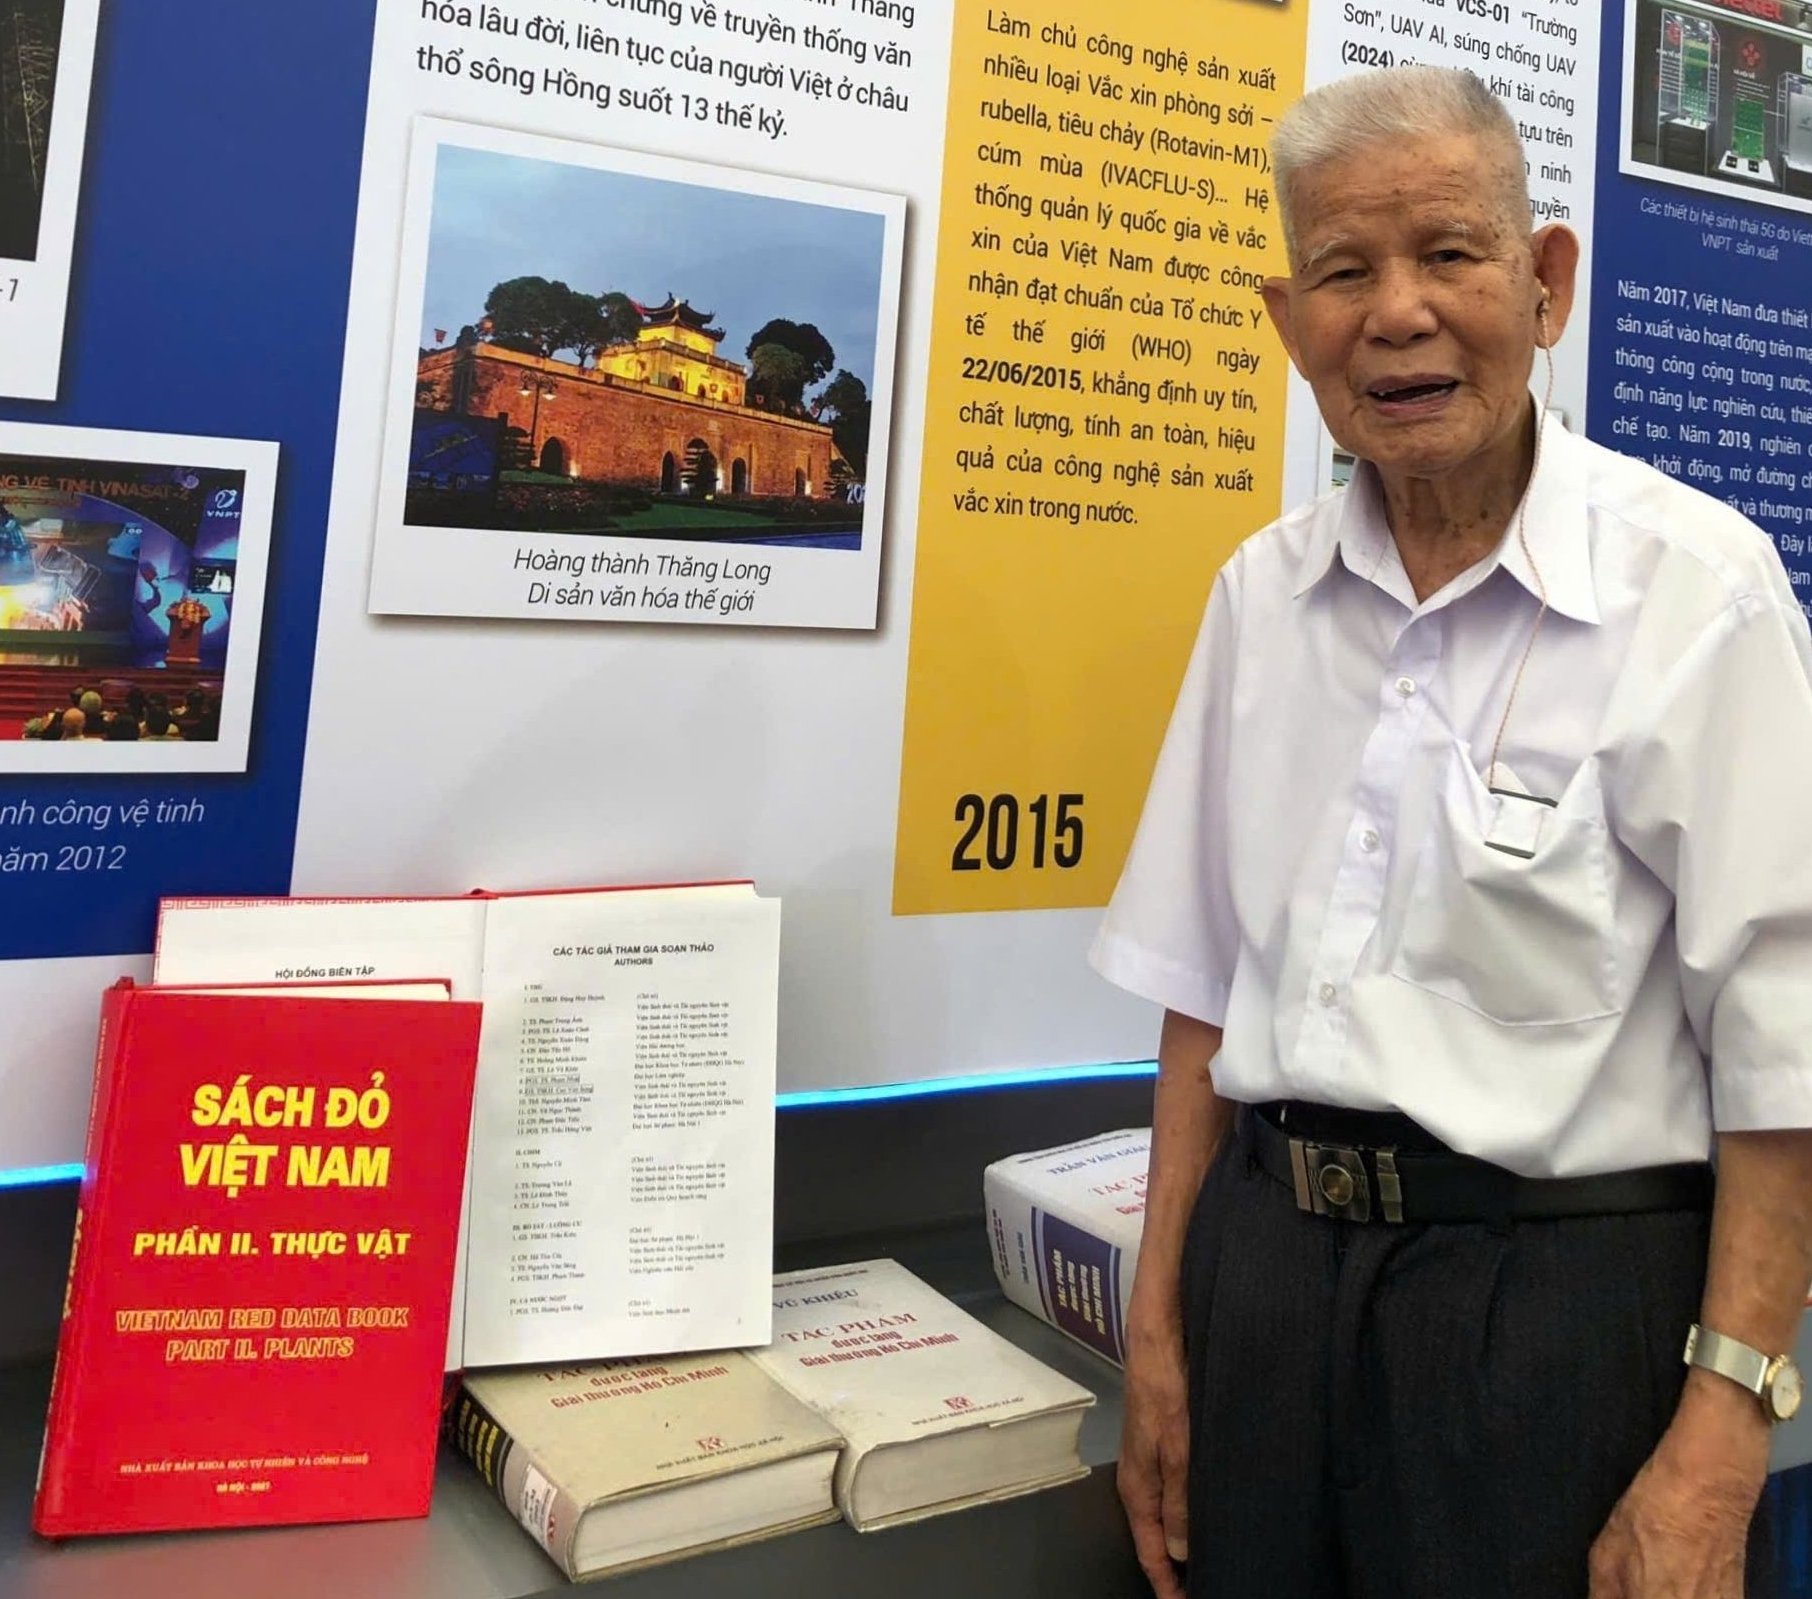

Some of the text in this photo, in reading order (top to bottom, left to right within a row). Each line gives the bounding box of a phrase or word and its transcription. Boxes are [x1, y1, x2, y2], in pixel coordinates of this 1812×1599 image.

[691, 5, 912, 67] về truyền thống văn
[1457, 0, 1510, 24] VCS-01
[420, 0, 909, 113] hóa lâu đời, liên tục của người Việt ở châu
[986, 9, 1277, 91] Làm chủ công nghệ sản xuất
[1391, 13, 1424, 38] UAV
[1453, 32, 1491, 60] súng
[1495, 42, 1541, 73] chống
[1546, 53, 1576, 76] UAV
[417, 45, 788, 140] thổ sông Hồng suốt 13 thế kỷ.
[983, 54, 1254, 127] nhiều loại Vắc xin phòng sởi
[1341, 40, 1575, 116] (2024) khí tài công
[980, 99, 1271, 174] rubella, tiêu chảy (Rotavin-M1),
[1518, 121, 1573, 148] tựu trên
[978, 143, 1270, 213] cúm mùa (IVACFLU-S)... Hệ
[1541, 162, 1572, 184] ninh
[975, 182, 1267, 251] thống quản lý quốc gia về vắc
[1618, 280, 1650, 301] Năm
[1693, 293, 1719, 313] Việt
[1721, 299, 1751, 318] Nam
[1755, 304, 1778, 323] đưa
[1782, 308, 1808, 329] thiết
[965, 311, 1260, 375] tế thế giới (WHO) ngày
[961, 357, 1258, 414] 22/06/2015, khẳng định uy tín,
[959, 401, 1256, 452] chất lượng, tính an toàn, hiệu
[1612, 416, 1639, 435] chế
[1647, 423, 1671, 441] tạo.
[1679, 425, 1710, 445] Năm
[1760, 436, 1801, 456] nghiên
[206, 510, 241, 519] VNPT
[953, 487, 1138, 525] vắc xin trong nước.
[513, 548, 771, 584] Hoàng thành Thăng Long
[528, 583, 756, 615] Di sản văn hóa thế giới
[43, 798, 204, 830] công vệ tinh
[952, 794, 1084, 870] 2015
[56, 845, 127, 871] 2012
[192, 1070, 391, 1129] SÁCH ĐỎ
[179, 1134, 391, 1198] VIỆT NAM
[134, 1225, 412, 1261] PHẦN II. THỰC VẬT
[115, 1307, 409, 1332] VIETNAM RED DATA BOOK
[166, 1337, 355, 1361] PART II. PLANTS
